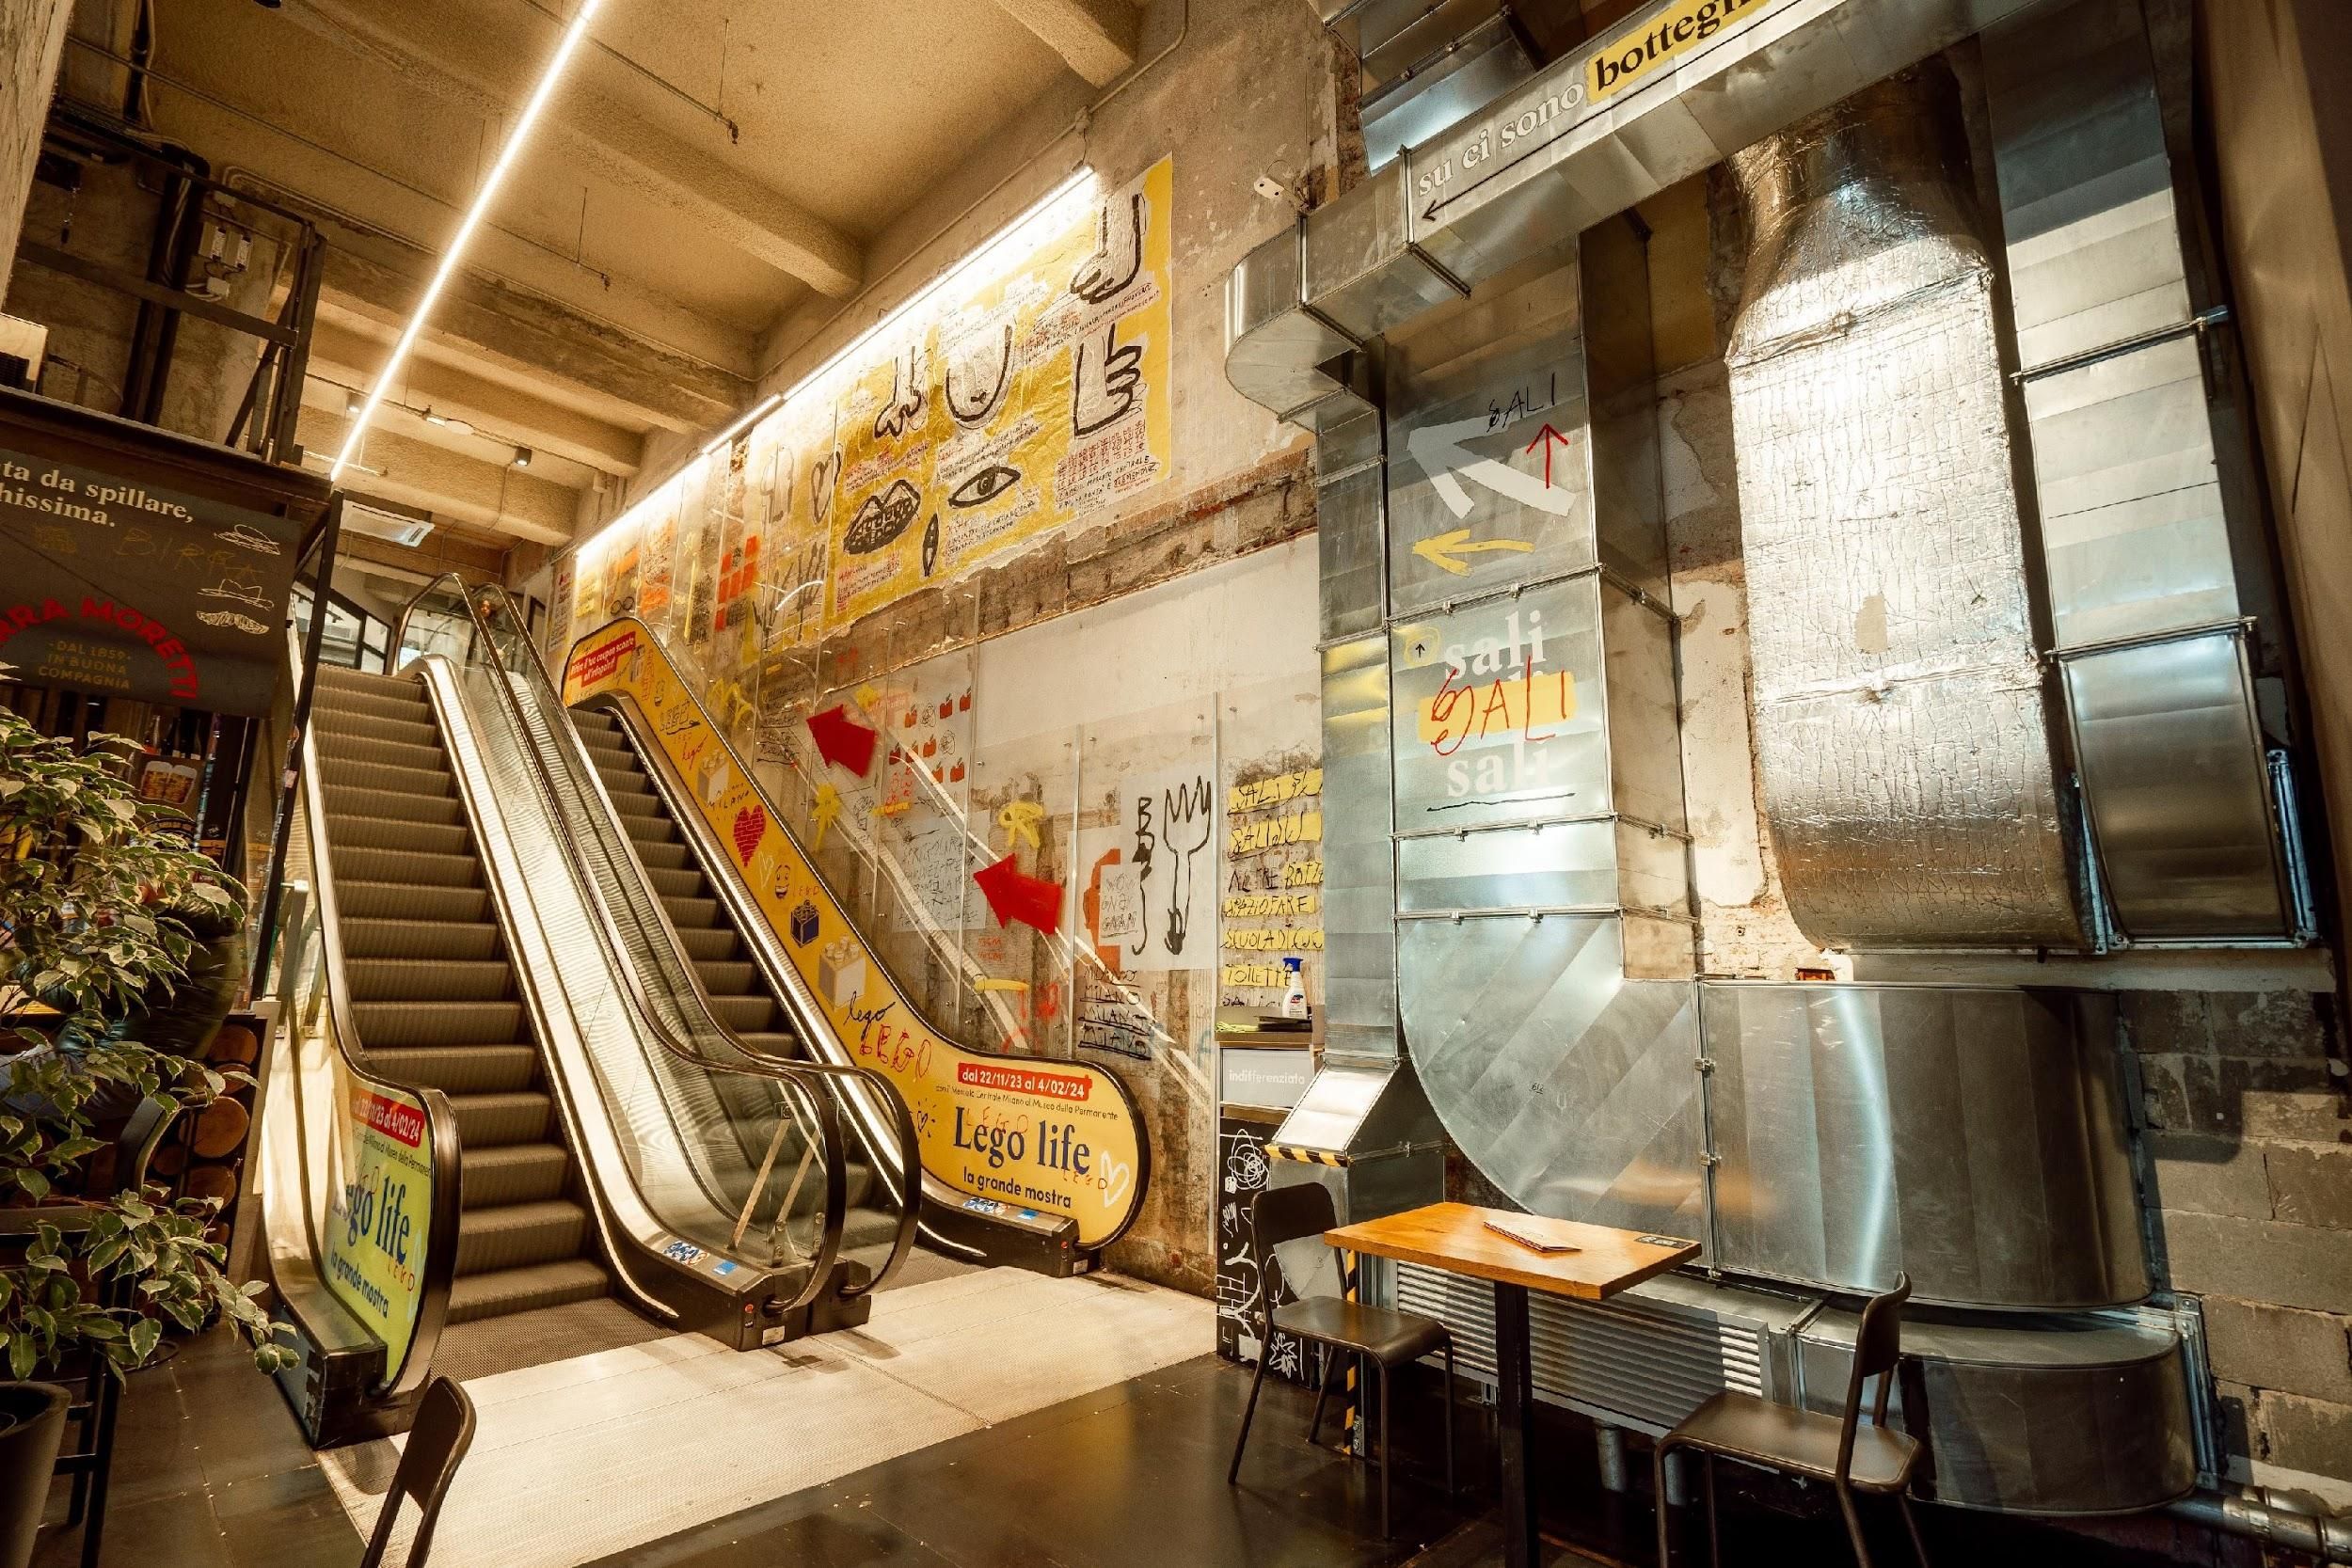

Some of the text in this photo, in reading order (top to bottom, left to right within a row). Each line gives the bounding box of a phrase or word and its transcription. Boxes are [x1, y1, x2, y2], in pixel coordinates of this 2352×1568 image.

[1418, 158, 1454, 197] su
[1462, 128, 1492, 170] ci
[1500, 82, 1586, 149] sono
[1486, 372, 1556, 433] SALI
[0, 461, 194, 523] ta da spillare,
[80, 594, 199, 700] MORETTI
[1444, 610, 1547, 680] sali
[1430, 655, 1567, 756] SALI
[1447, 737, 1552, 798] sali
[961, 1068, 1085, 1099] dal 22/11/23 al 4/02/24
[1229, 1069, 1305, 1085] indifferenziata
[391, 1112, 421, 1142] 4/02/24
[953, 1106, 1090, 1175] Lego life
[963, 1166, 1072, 1209] la grande mostra
[375, 1175, 410, 1265] life
[337, 1258, 362, 1291] grande
[361, 1279, 389, 1319] mostra
